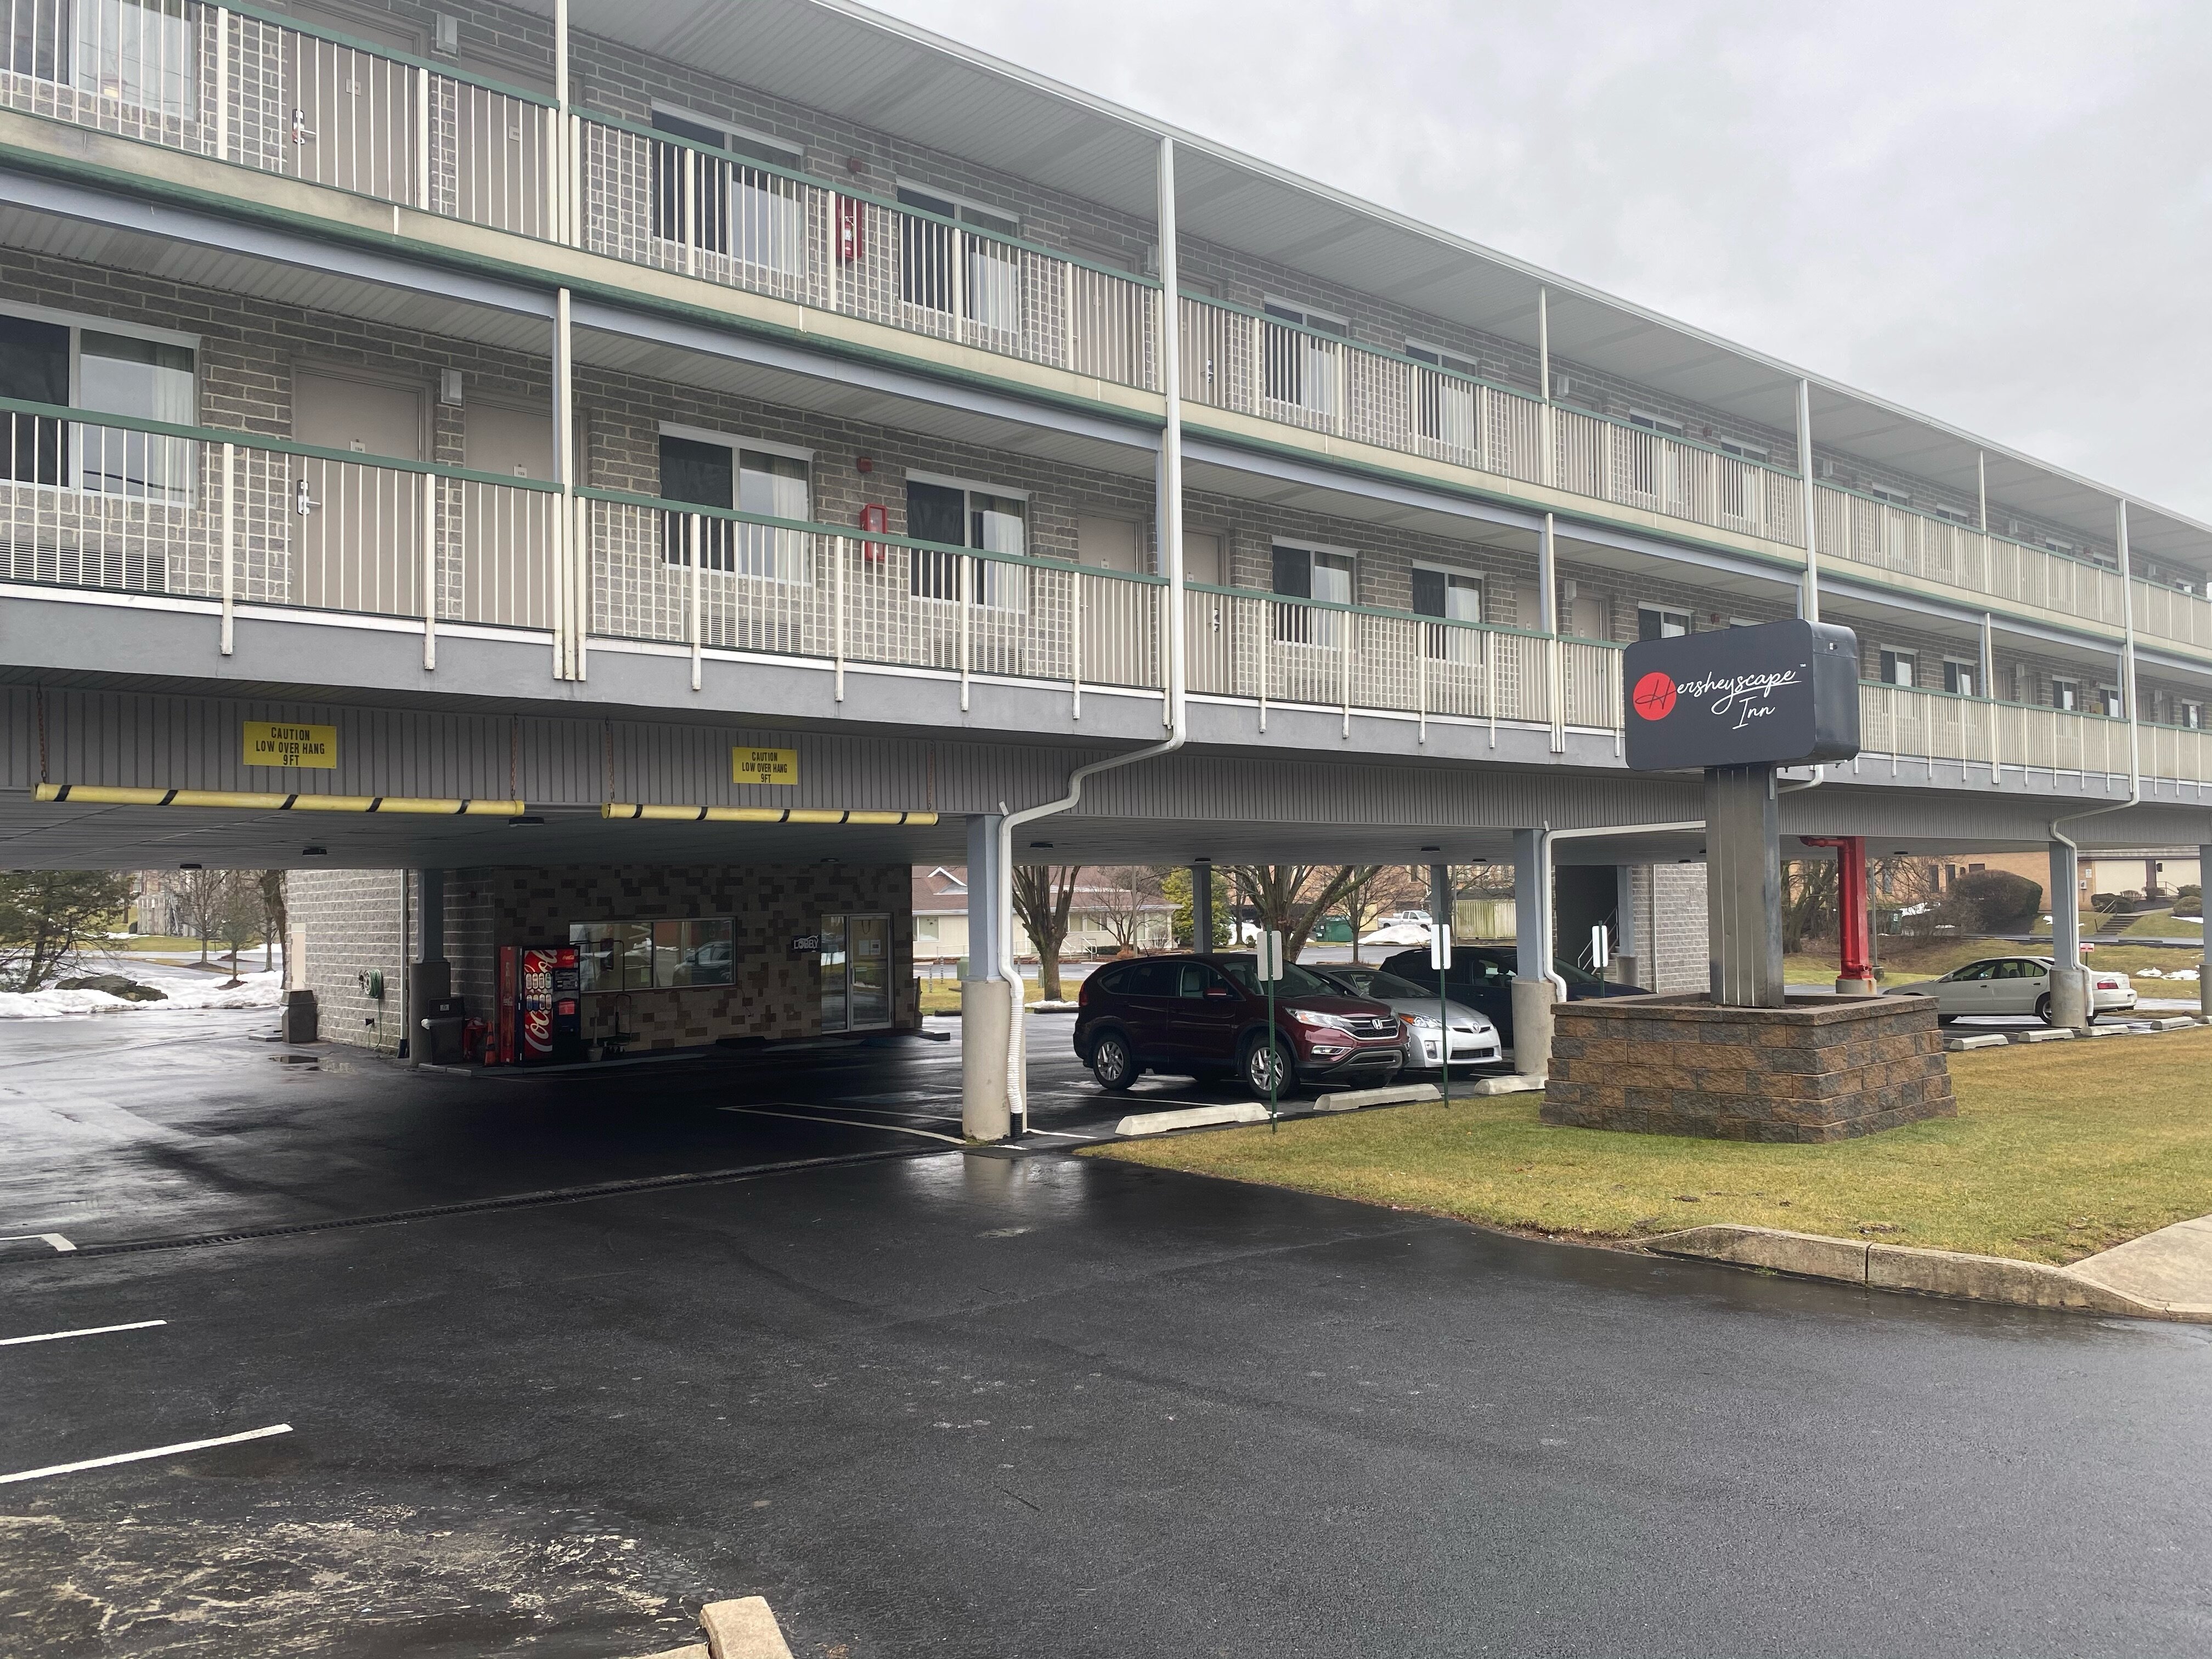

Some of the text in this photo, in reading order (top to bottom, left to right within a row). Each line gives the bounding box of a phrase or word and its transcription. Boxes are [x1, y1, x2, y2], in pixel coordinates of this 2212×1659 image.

[1635, 672, 1802, 715] Hersheyscape
[1733, 696, 1775, 730] Inn
[271, 727, 310, 741] CAUTION
[256, 740, 325, 754] LOW OVER HANG
[283, 754, 300, 766] 9FT
[752, 752, 778, 761] CAUTION
[742, 762, 787, 773] LOW OVER HANG
[761, 774, 771, 783] 9FT
[794, 938, 819, 949] LOBBY
